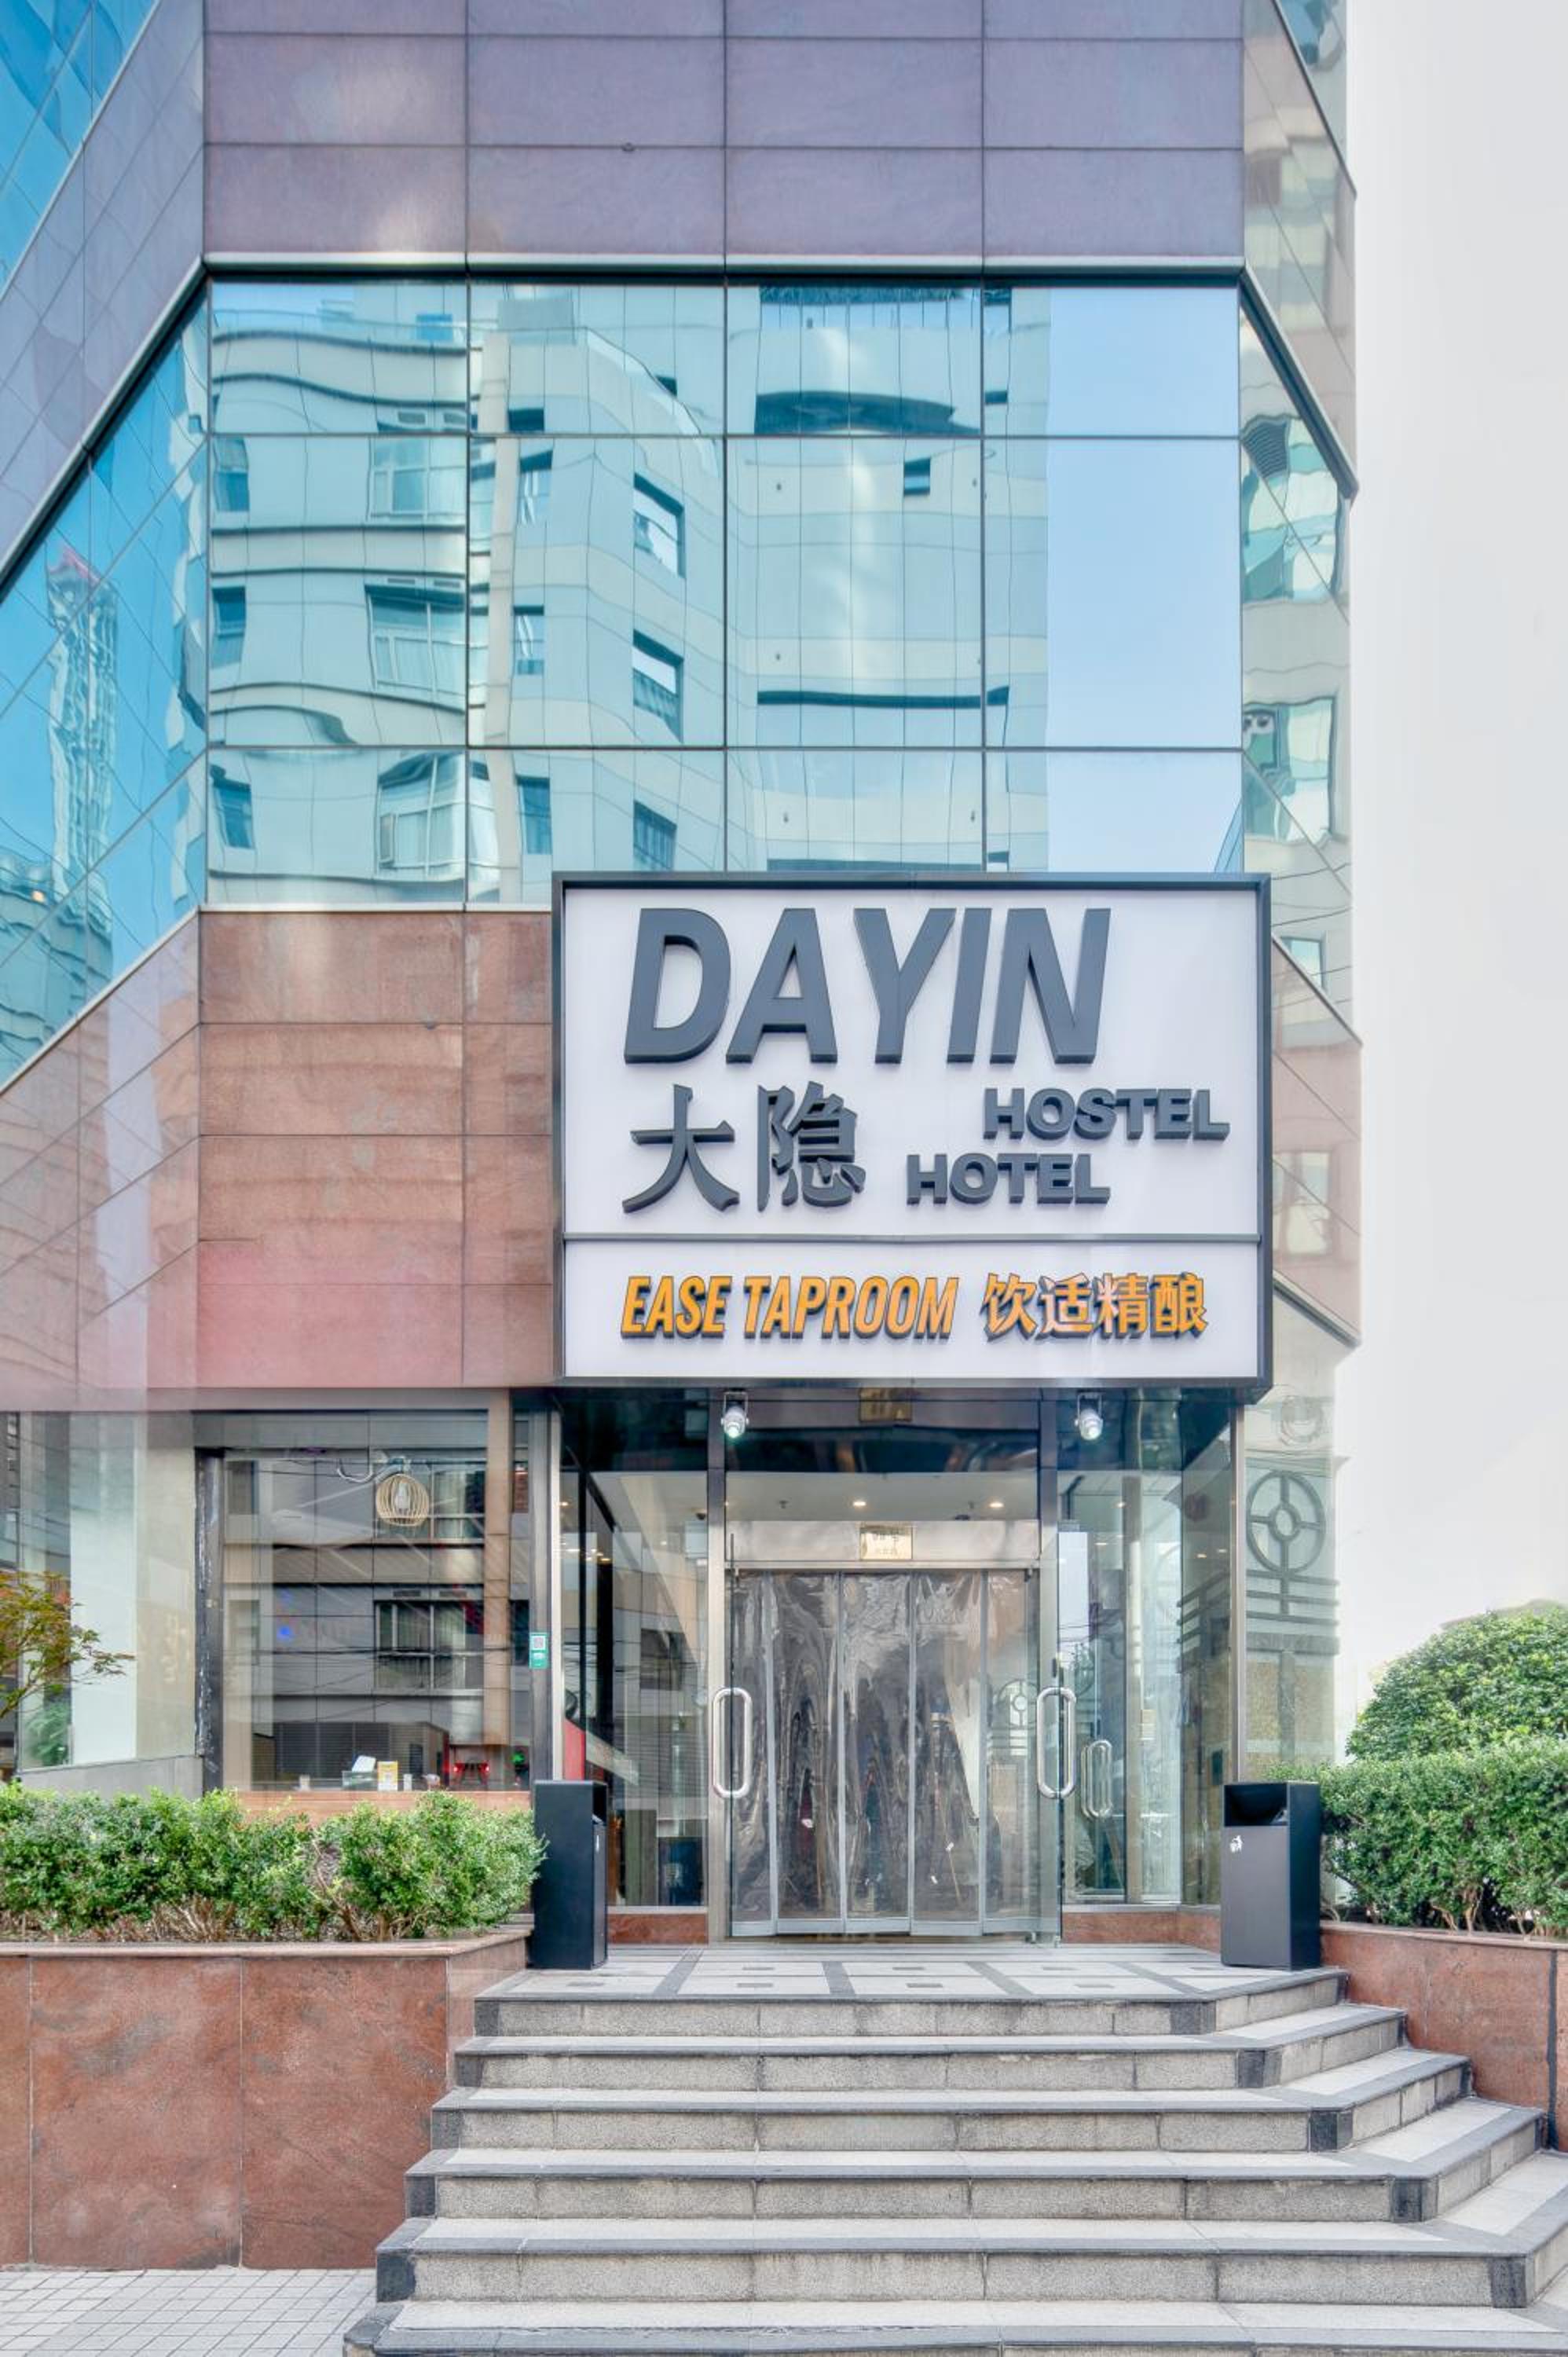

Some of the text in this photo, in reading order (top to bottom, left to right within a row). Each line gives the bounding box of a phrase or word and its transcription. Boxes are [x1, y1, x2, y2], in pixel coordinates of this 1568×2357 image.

[623, 907, 1112, 1065] DAYIN
[622, 1081, 866, 1214] 大隐
[983, 1087, 1230, 1141] HOSTEL
[906, 1153, 1111, 1205] HOTEL
[620, 1276, 959, 1339] EASE TAPROOM
[981, 1271, 1208, 1342] 饮适精酿
